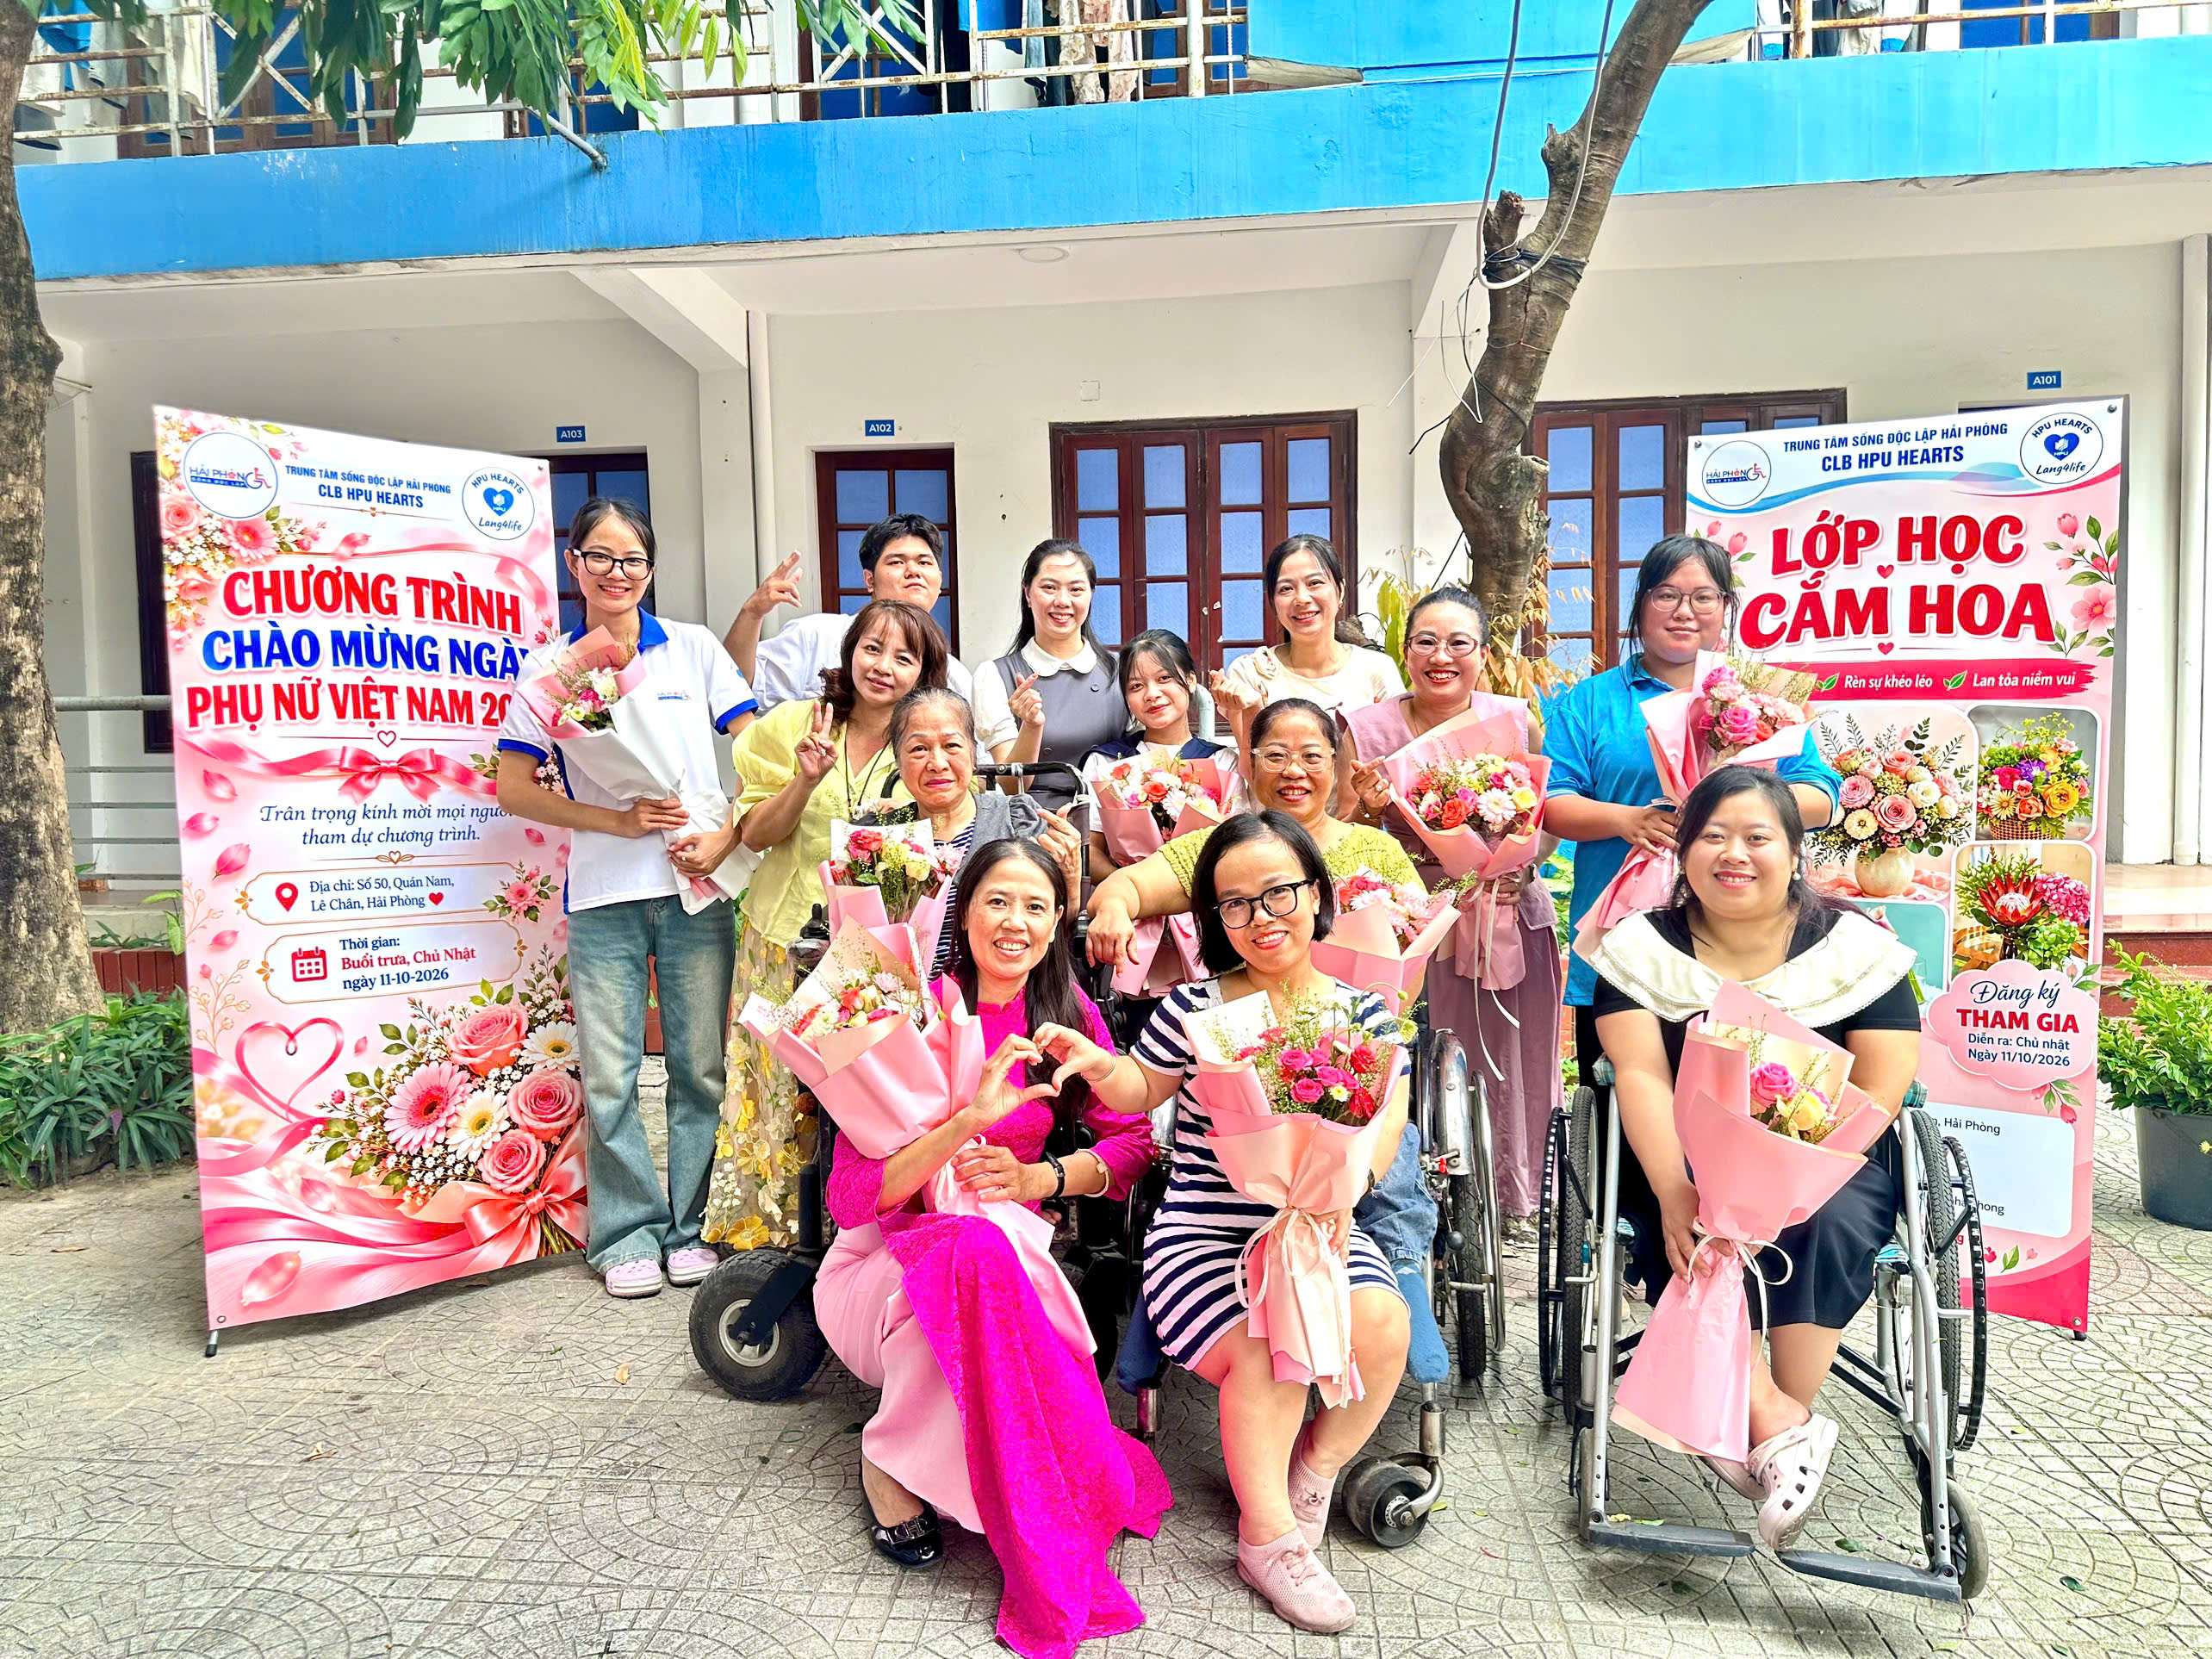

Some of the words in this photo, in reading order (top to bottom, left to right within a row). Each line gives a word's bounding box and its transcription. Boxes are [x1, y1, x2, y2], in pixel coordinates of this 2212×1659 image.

[2033, 376, 2056, 385] A101
[561, 430, 582, 438] A103
[869, 424, 892, 432] A102
[1784, 439, 1820, 452] TRUNG
[1824, 437, 1848, 449] TÂM
[1852, 432, 1884, 446] SỐNG
[1887, 431, 1911, 445] ĐỘC
[1915, 427, 1937, 444] LẬP
[1942, 424, 1961, 439] HẢI
[1965, 422, 2008, 438] PHÒNG
[2032, 422, 2051, 438] HPU
[2054, 419, 2092, 434] HEARTS
[1822, 455, 1852, 472] CLB
[1858, 451, 1892, 469] HPU
[1898, 445, 1964, 467] HEARTS
[2036, 462, 2085, 475] Lang4life
[285, 465, 316, 477] TRUNG
[319, 469, 338, 480] TÂM
[341, 470, 365, 483] SỐNG
[367, 475, 385, 488] ĐỘC
[388, 477, 403, 489] LẬP
[406, 478, 420, 490] HẢI
[423, 482, 451, 494] PHÒNG
[471, 474, 488, 488] HPU
[490, 473, 524, 494] HEARTS
[318, 484, 343, 499] CLB
[347, 488, 372, 502] HPU
[376, 491, 424, 508] HEARTS
[479, 517, 522, 531] Lang4life
[1772, 510, 1880, 575] LỚP
[1897, 514, 2025, 574] HỌC
[223, 564, 398, 617] CHƯƠNG
[407, 571, 523, 636] TRÌNH
[1739, 570, 1889, 650] CẮM
[1909, 583, 2056, 643] HOA
[202, 621, 320, 671] CHÀO
[330, 624, 439, 674] MỪNG
[450, 633, 530, 681] NGÀ
[1844, 674, 1866, 688] Rèn
[1868, 676, 1882, 691] sự
[1885, 673, 1912, 688] khéo
[1915, 673, 1933, 687] léo
[1973, 674, 1994, 687] Lan
[1998, 672, 2019, 687] tỏa
[2022, 670, 2053, 686] niềm
[2057, 672, 2076, 686] vui
[187, 684, 262, 731] PHỤ
[274, 675, 322, 722] NỮ
[328, 676, 399, 728] VIỆT
[407, 686, 475, 724] NAM
[481, 692, 512, 728] 20
[260, 805, 306, 822] Trân
[311, 806, 356, 825] trọng
[363, 803, 397, 820] kính
[402, 805, 432, 819] mời
[436, 803, 465, 823] mọi
[471, 805, 513, 823] ngư
[302, 828, 346, 846] tham
[351, 827, 374, 847] dự
[377, 827, 434, 846] chương
[439, 824, 480, 842] trình.
[310, 879, 331, 894] Địa
[357, 875, 372, 891] Số
[374, 878, 391, 891] 50,
[394, 877, 423, 891] Quán
[426, 875, 455, 889] Nam,
[311, 898, 326, 912] Lê
[328, 897, 363, 911] Chân,
[366, 895, 387, 909] Hải
[390, 894, 426, 910] Phòng
[339, 936, 369, 951] Thời
[371, 936, 400, 951] gian:
[341, 951, 374, 970] Buổi
[378, 954, 410, 969] trưa,
[413, 950, 440, 965] Chủ
[444, 947, 475, 964] Nhật
[343, 976, 376, 992] ngày
[380, 967, 449, 987] 11-10-2026
[1970, 980, 2034, 1009] Đăng
[2038, 980, 2060, 1008] ký
[1956, 1009, 2029, 1030] THAM
[2036, 1013, 2079, 1034] GIA
[1968, 1033, 1994, 1045] Diễn
[1998, 1036, 2012, 1046] ra:
[2016, 1036, 2039, 1047] Chủ
[2042, 1039, 2070, 1051] nhật
[1968, 1048, 1998, 1062] Ngày
[2002, 1051, 2070, 1066] 11/10/2026
[1944, 1117, 1961, 1128] Hải
[1966, 1120, 2000, 1135] Phòng
